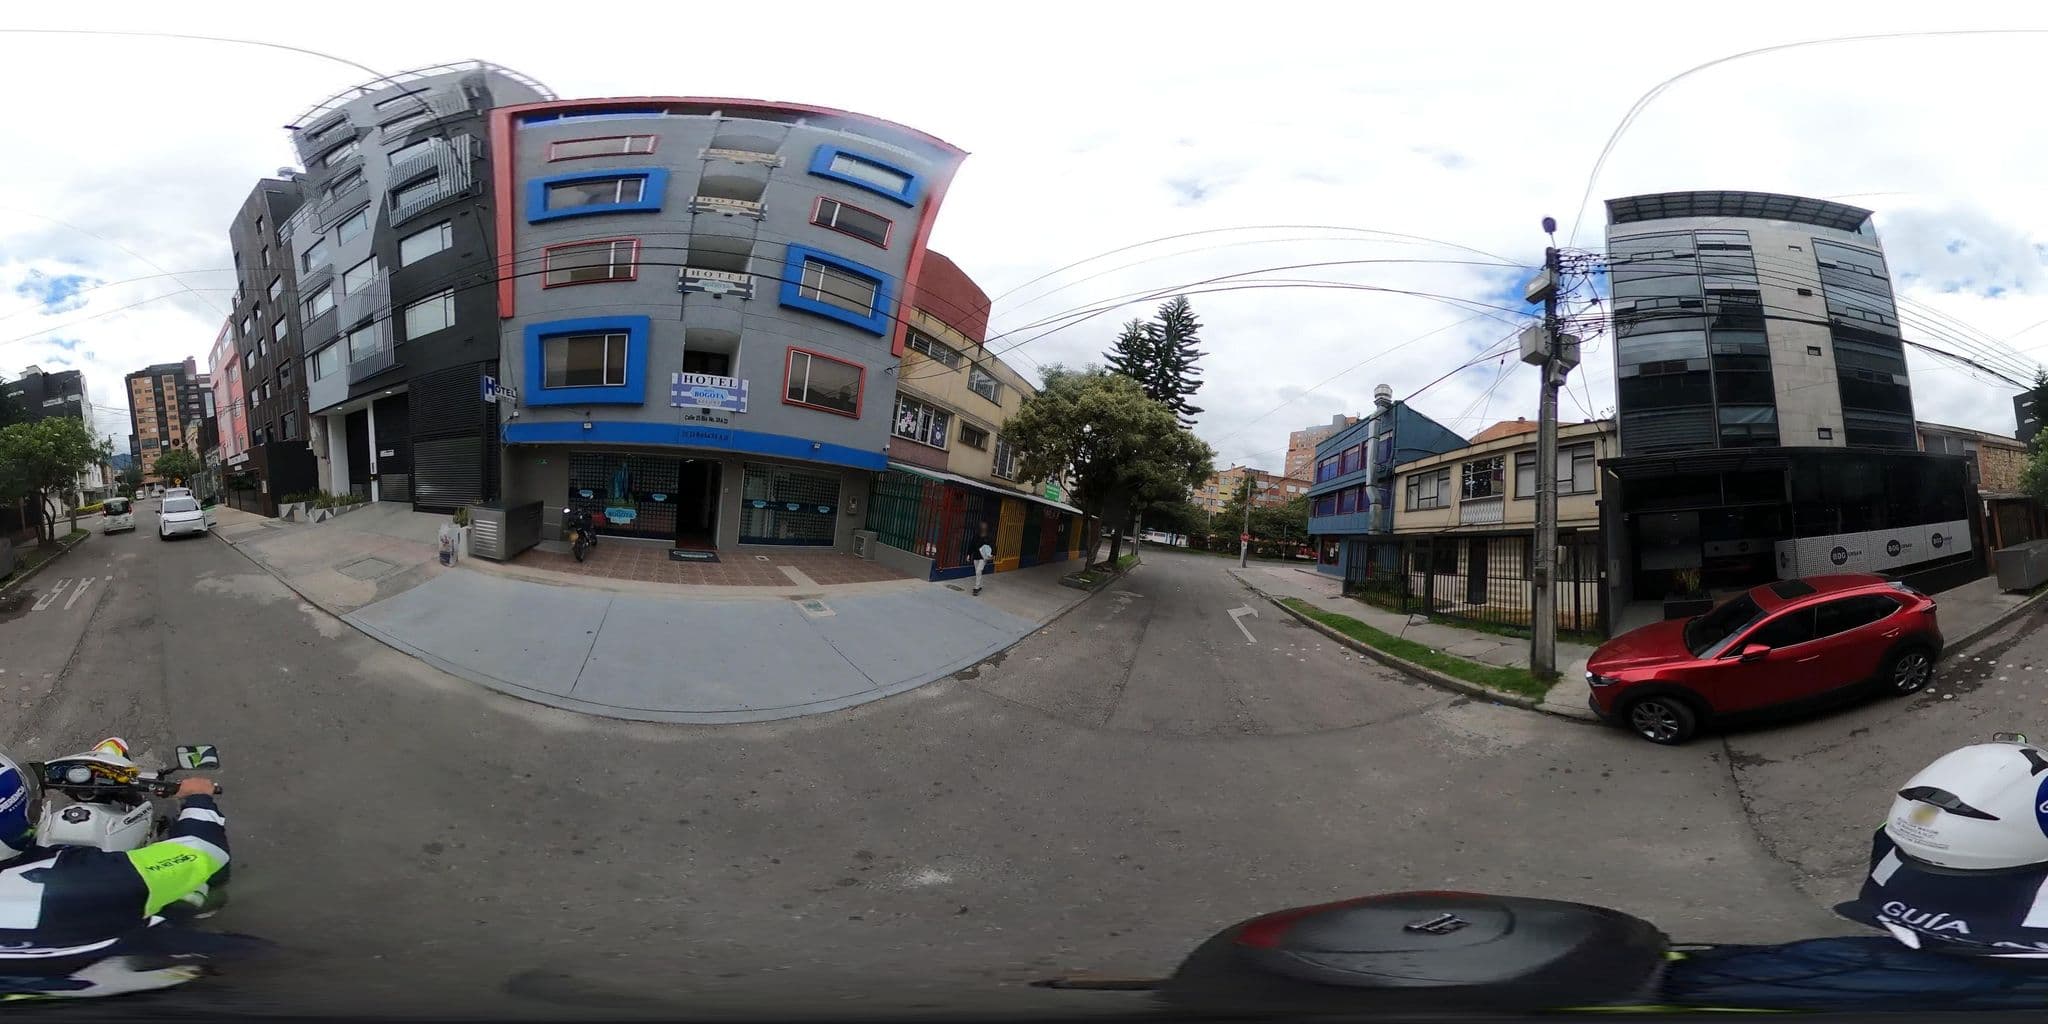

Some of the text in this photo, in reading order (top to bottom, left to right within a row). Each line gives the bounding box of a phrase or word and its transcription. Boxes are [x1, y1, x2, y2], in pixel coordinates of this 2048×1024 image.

[691, 270, 746, 282] HOTEL
[485, 377, 516, 397] HOTEL
[684, 374, 737, 388] HOTEL
